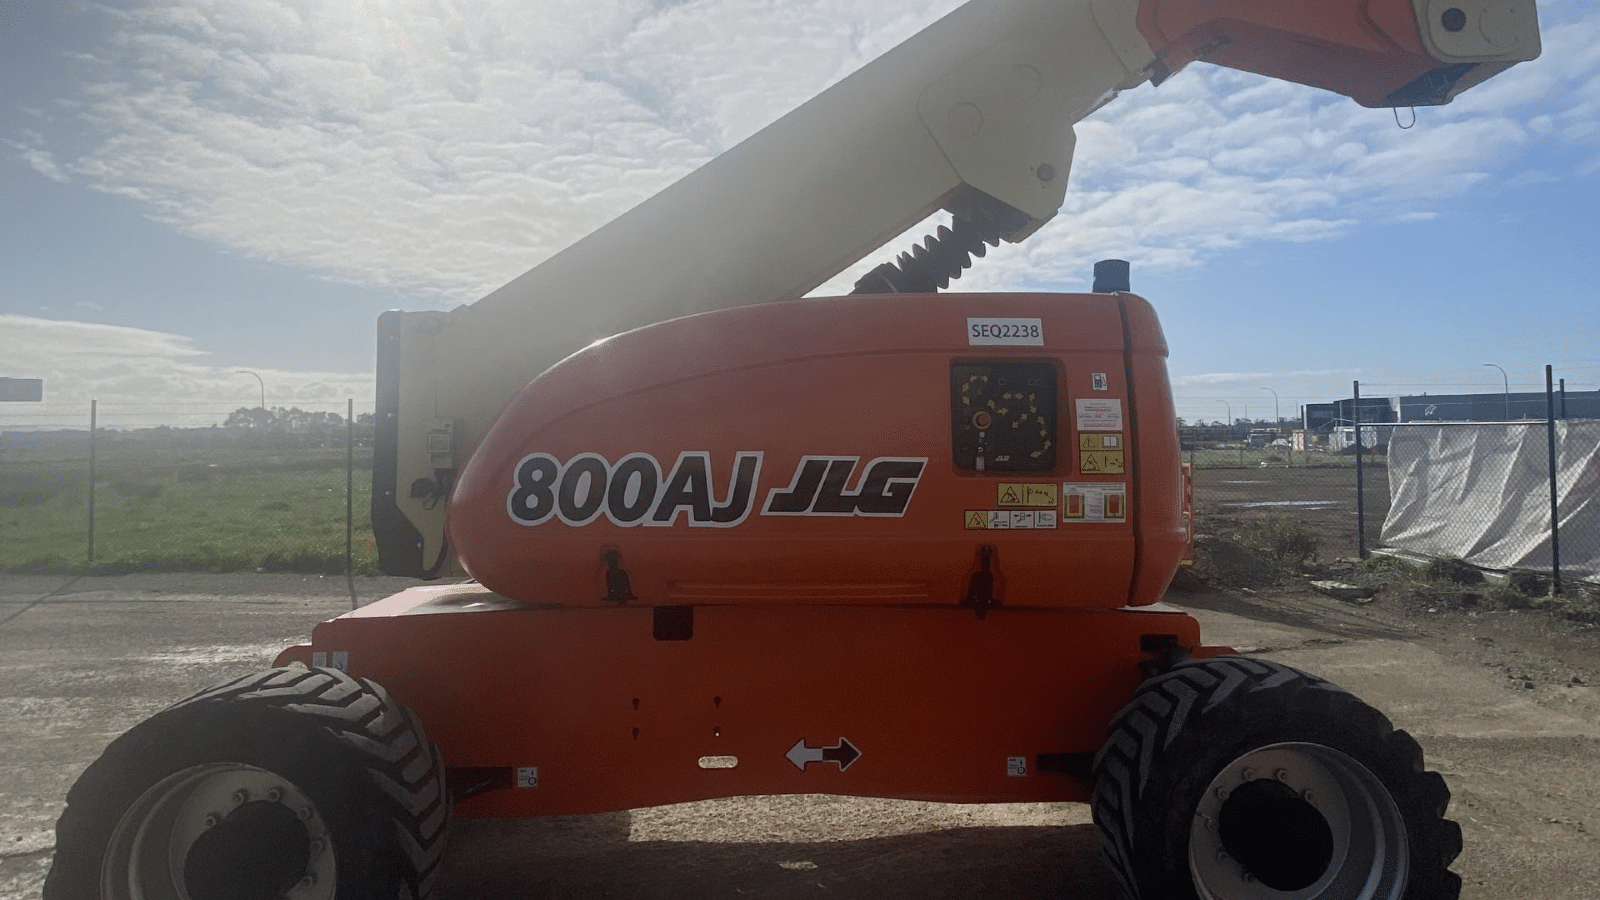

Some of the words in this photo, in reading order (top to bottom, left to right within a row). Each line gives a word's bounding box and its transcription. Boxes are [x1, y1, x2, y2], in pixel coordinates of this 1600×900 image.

[971, 324, 1039, 338] SEQ2238
[507, 451, 764, 527] 800AJ
[760, 455, 928, 517] JLG
